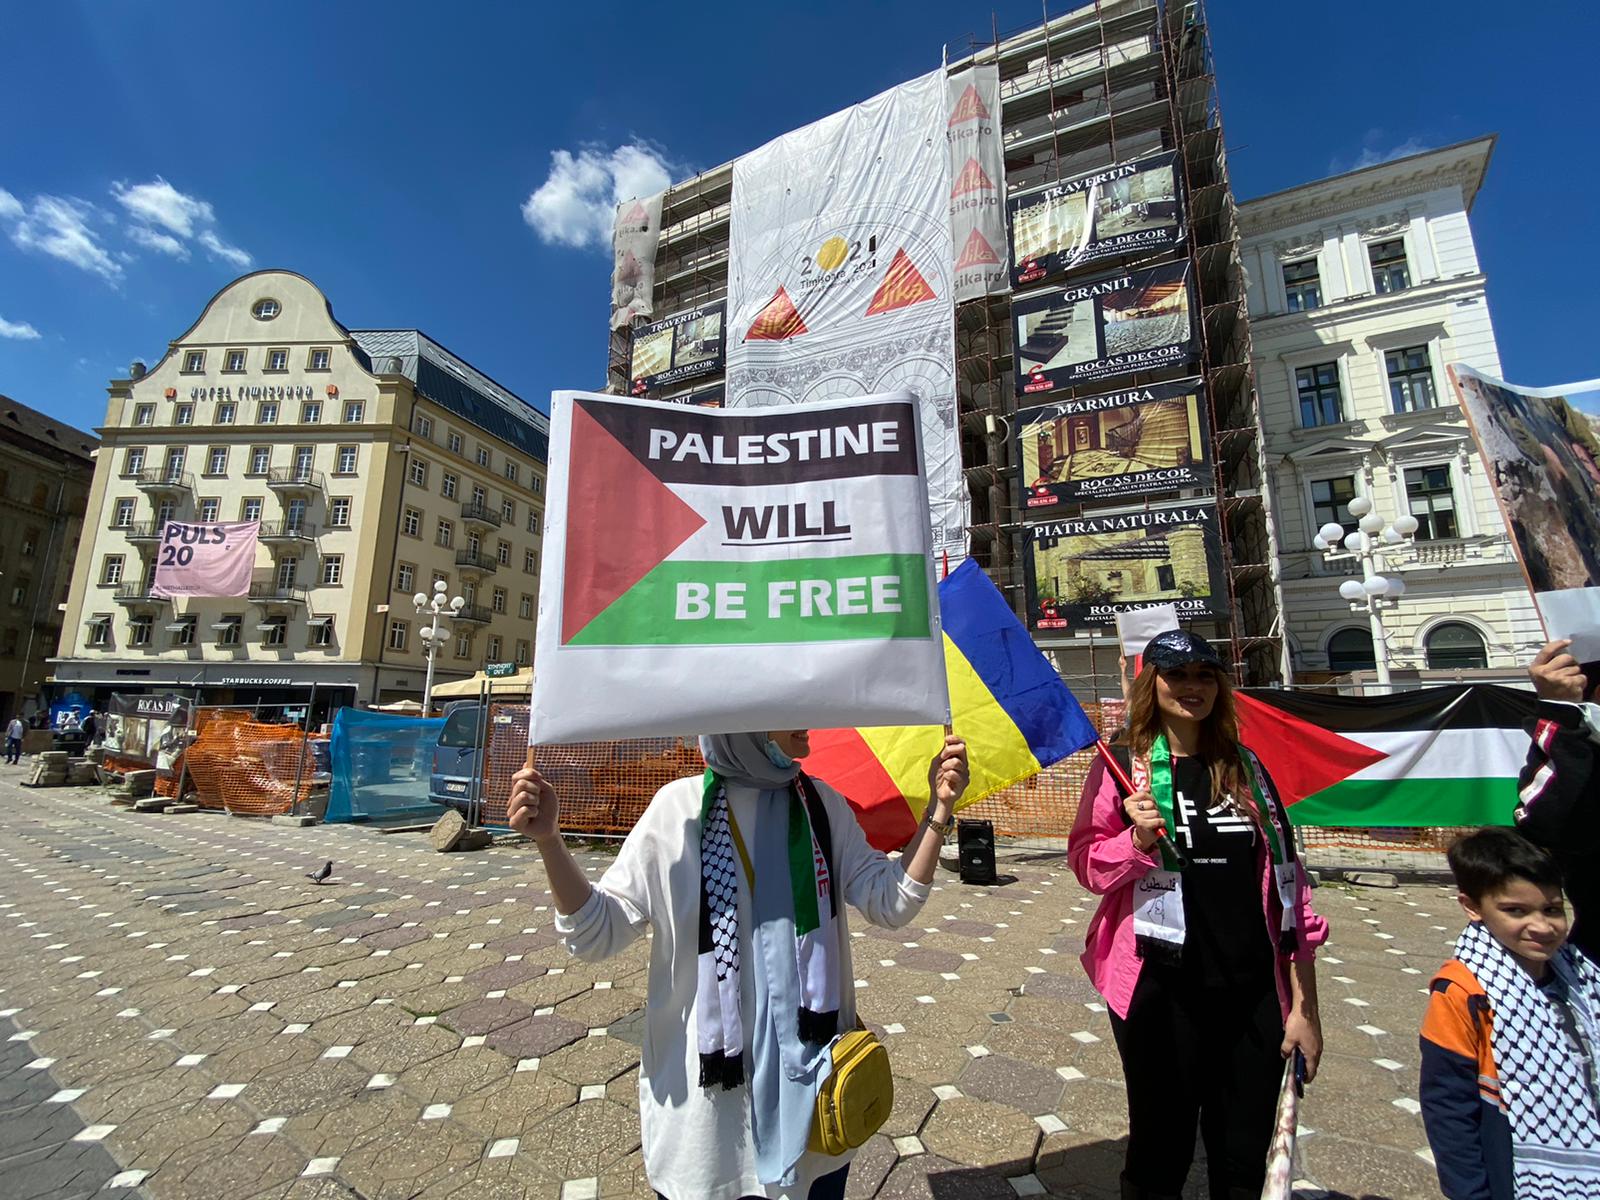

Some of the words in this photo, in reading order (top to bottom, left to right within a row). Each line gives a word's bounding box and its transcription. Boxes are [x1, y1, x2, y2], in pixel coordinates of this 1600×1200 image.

[1042, 164, 1137, 200] TRAVERTIN
[1117, 228, 1167, 245] DECOR
[953, 272, 1002, 290] sika.ro
[1063, 276, 1132, 302] GRANIT
[651, 309, 704, 332] TRAVERTIN
[1074, 356, 1124, 374] ROCAS
[1127, 345, 1180, 363] DECOR
[1056, 389, 1154, 416] MARMURA
[648, 421, 900, 465] PALESTINE
[1080, 475, 1131, 490] ROCAS
[721, 500, 852, 541] WILL
[1034, 520, 1098, 538] PIATRA
[1102, 509, 1209, 531] NATURALA
[164, 525, 226, 545] PULS
[160, 545, 194, 567] 20
[675, 582, 747, 620] BE
[767, 575, 903, 619] FREE
[222, 677, 262, 685] STARBUCKS
[137, 699, 164, 712] ROCAS
